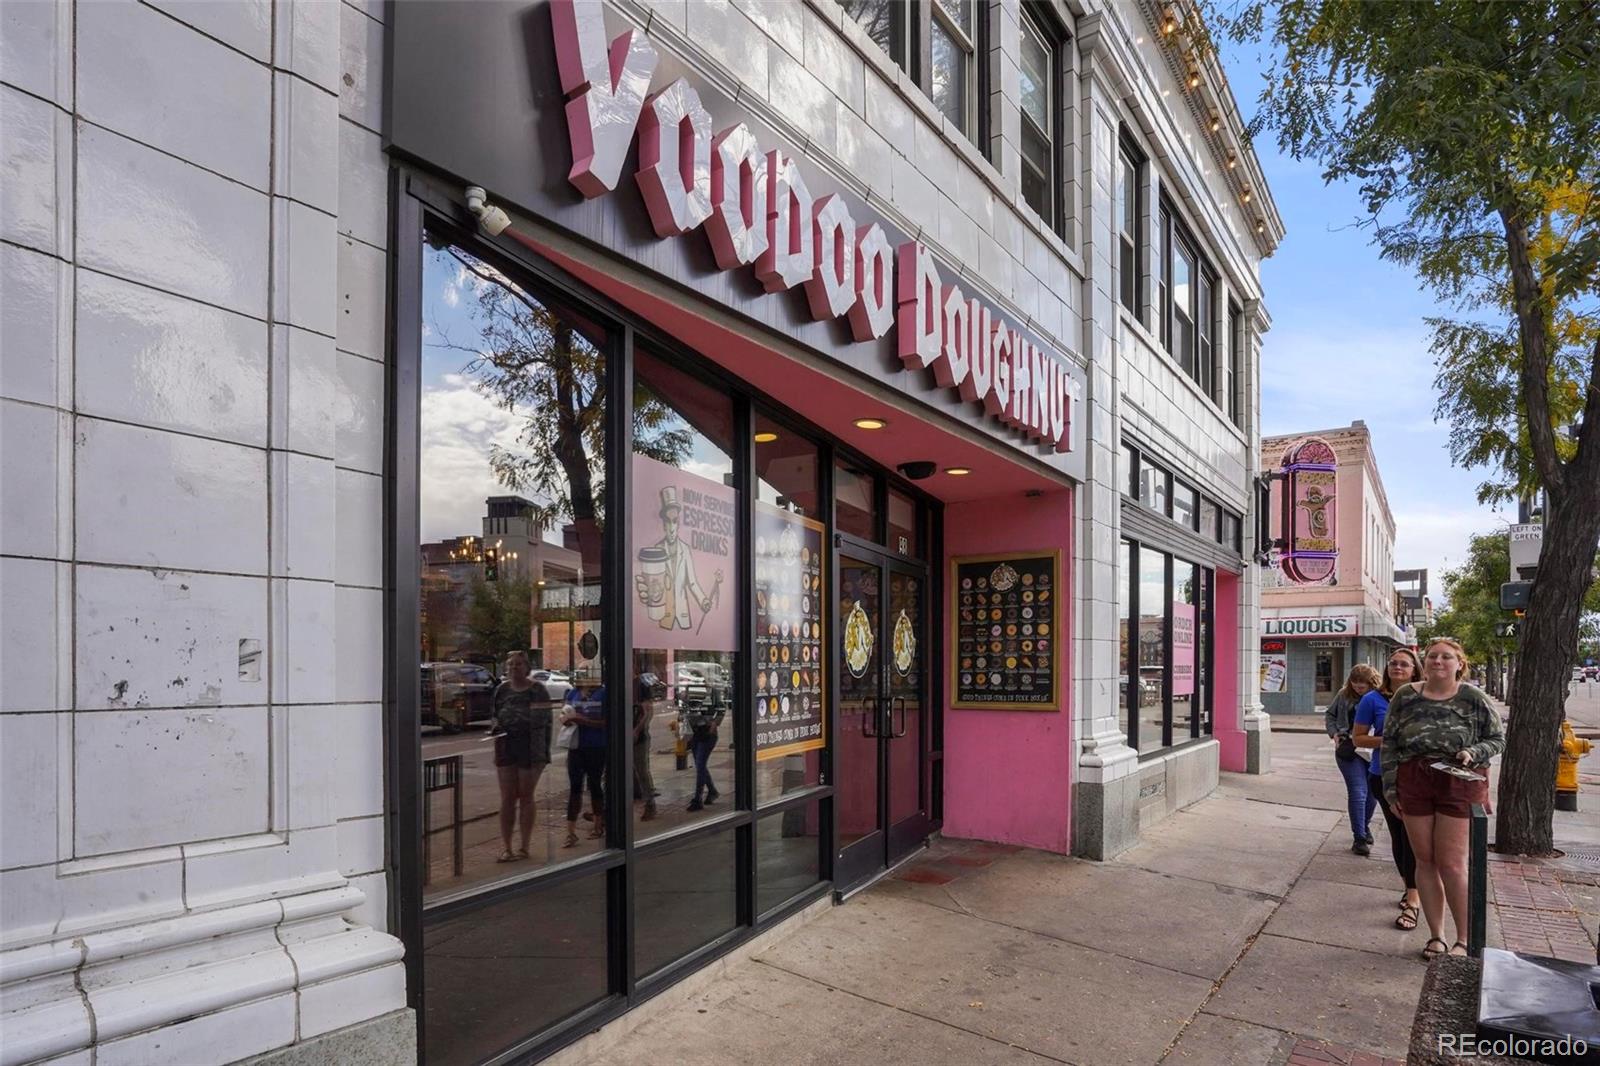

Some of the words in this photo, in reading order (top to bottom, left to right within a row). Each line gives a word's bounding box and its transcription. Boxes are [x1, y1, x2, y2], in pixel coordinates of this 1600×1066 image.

[898, 240, 1081, 453] DOUGHNUT
[1512, 525, 1529, 533] LEFT
[691, 530, 728, 557] DRINKS
[1265, 618, 1347, 635] LIQUORS
